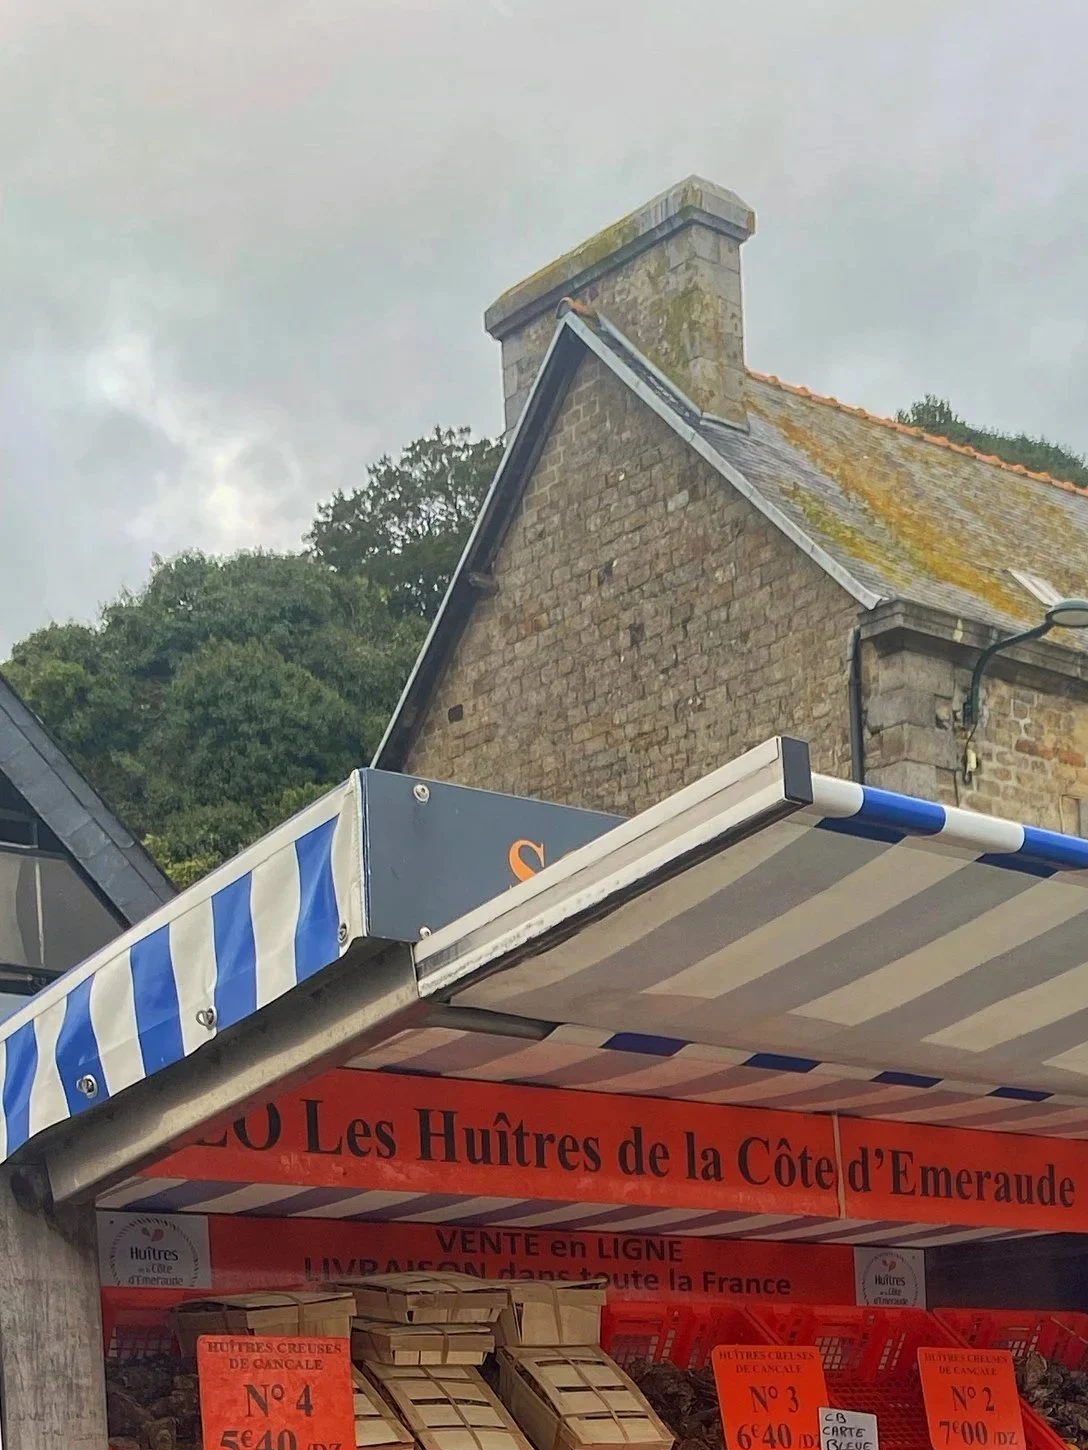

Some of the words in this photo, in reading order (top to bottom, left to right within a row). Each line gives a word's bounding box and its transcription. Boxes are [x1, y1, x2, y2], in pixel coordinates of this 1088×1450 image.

[301, 1099, 396, 1159] Les
[414, 1107, 602, 1173] Huîtres
[618, 1126, 671, 1178] de
[685, 1131, 724, 1182] la
[737, 1137, 835, 1190] Côte
[847, 1146, 1076, 1208] d'Emeraude
[130, 1246, 179, 1261] Huîtres
[436, 1229, 540, 1257] VENTE
[550, 1238, 586, 1258] en
[597, 1237, 684, 1262] LIGNE
[669, 1267, 692, 1292] la
[702, 1270, 791, 1297] France
[207, 1340, 273, 1353] HUÎTRES
[276, 1342, 342, 1354] CREUSES
[229, 1358, 249, 1370] DE
[296, 1384, 314, 1417] 4
[787, 1385, 800, 1414] 3
[982, 1386, 995, 1412] 2
[824, 1412, 847, 1424] CB
[737, 1423, 792, 1450] 6€40
[822, 1426, 866, 1438] CARTE
